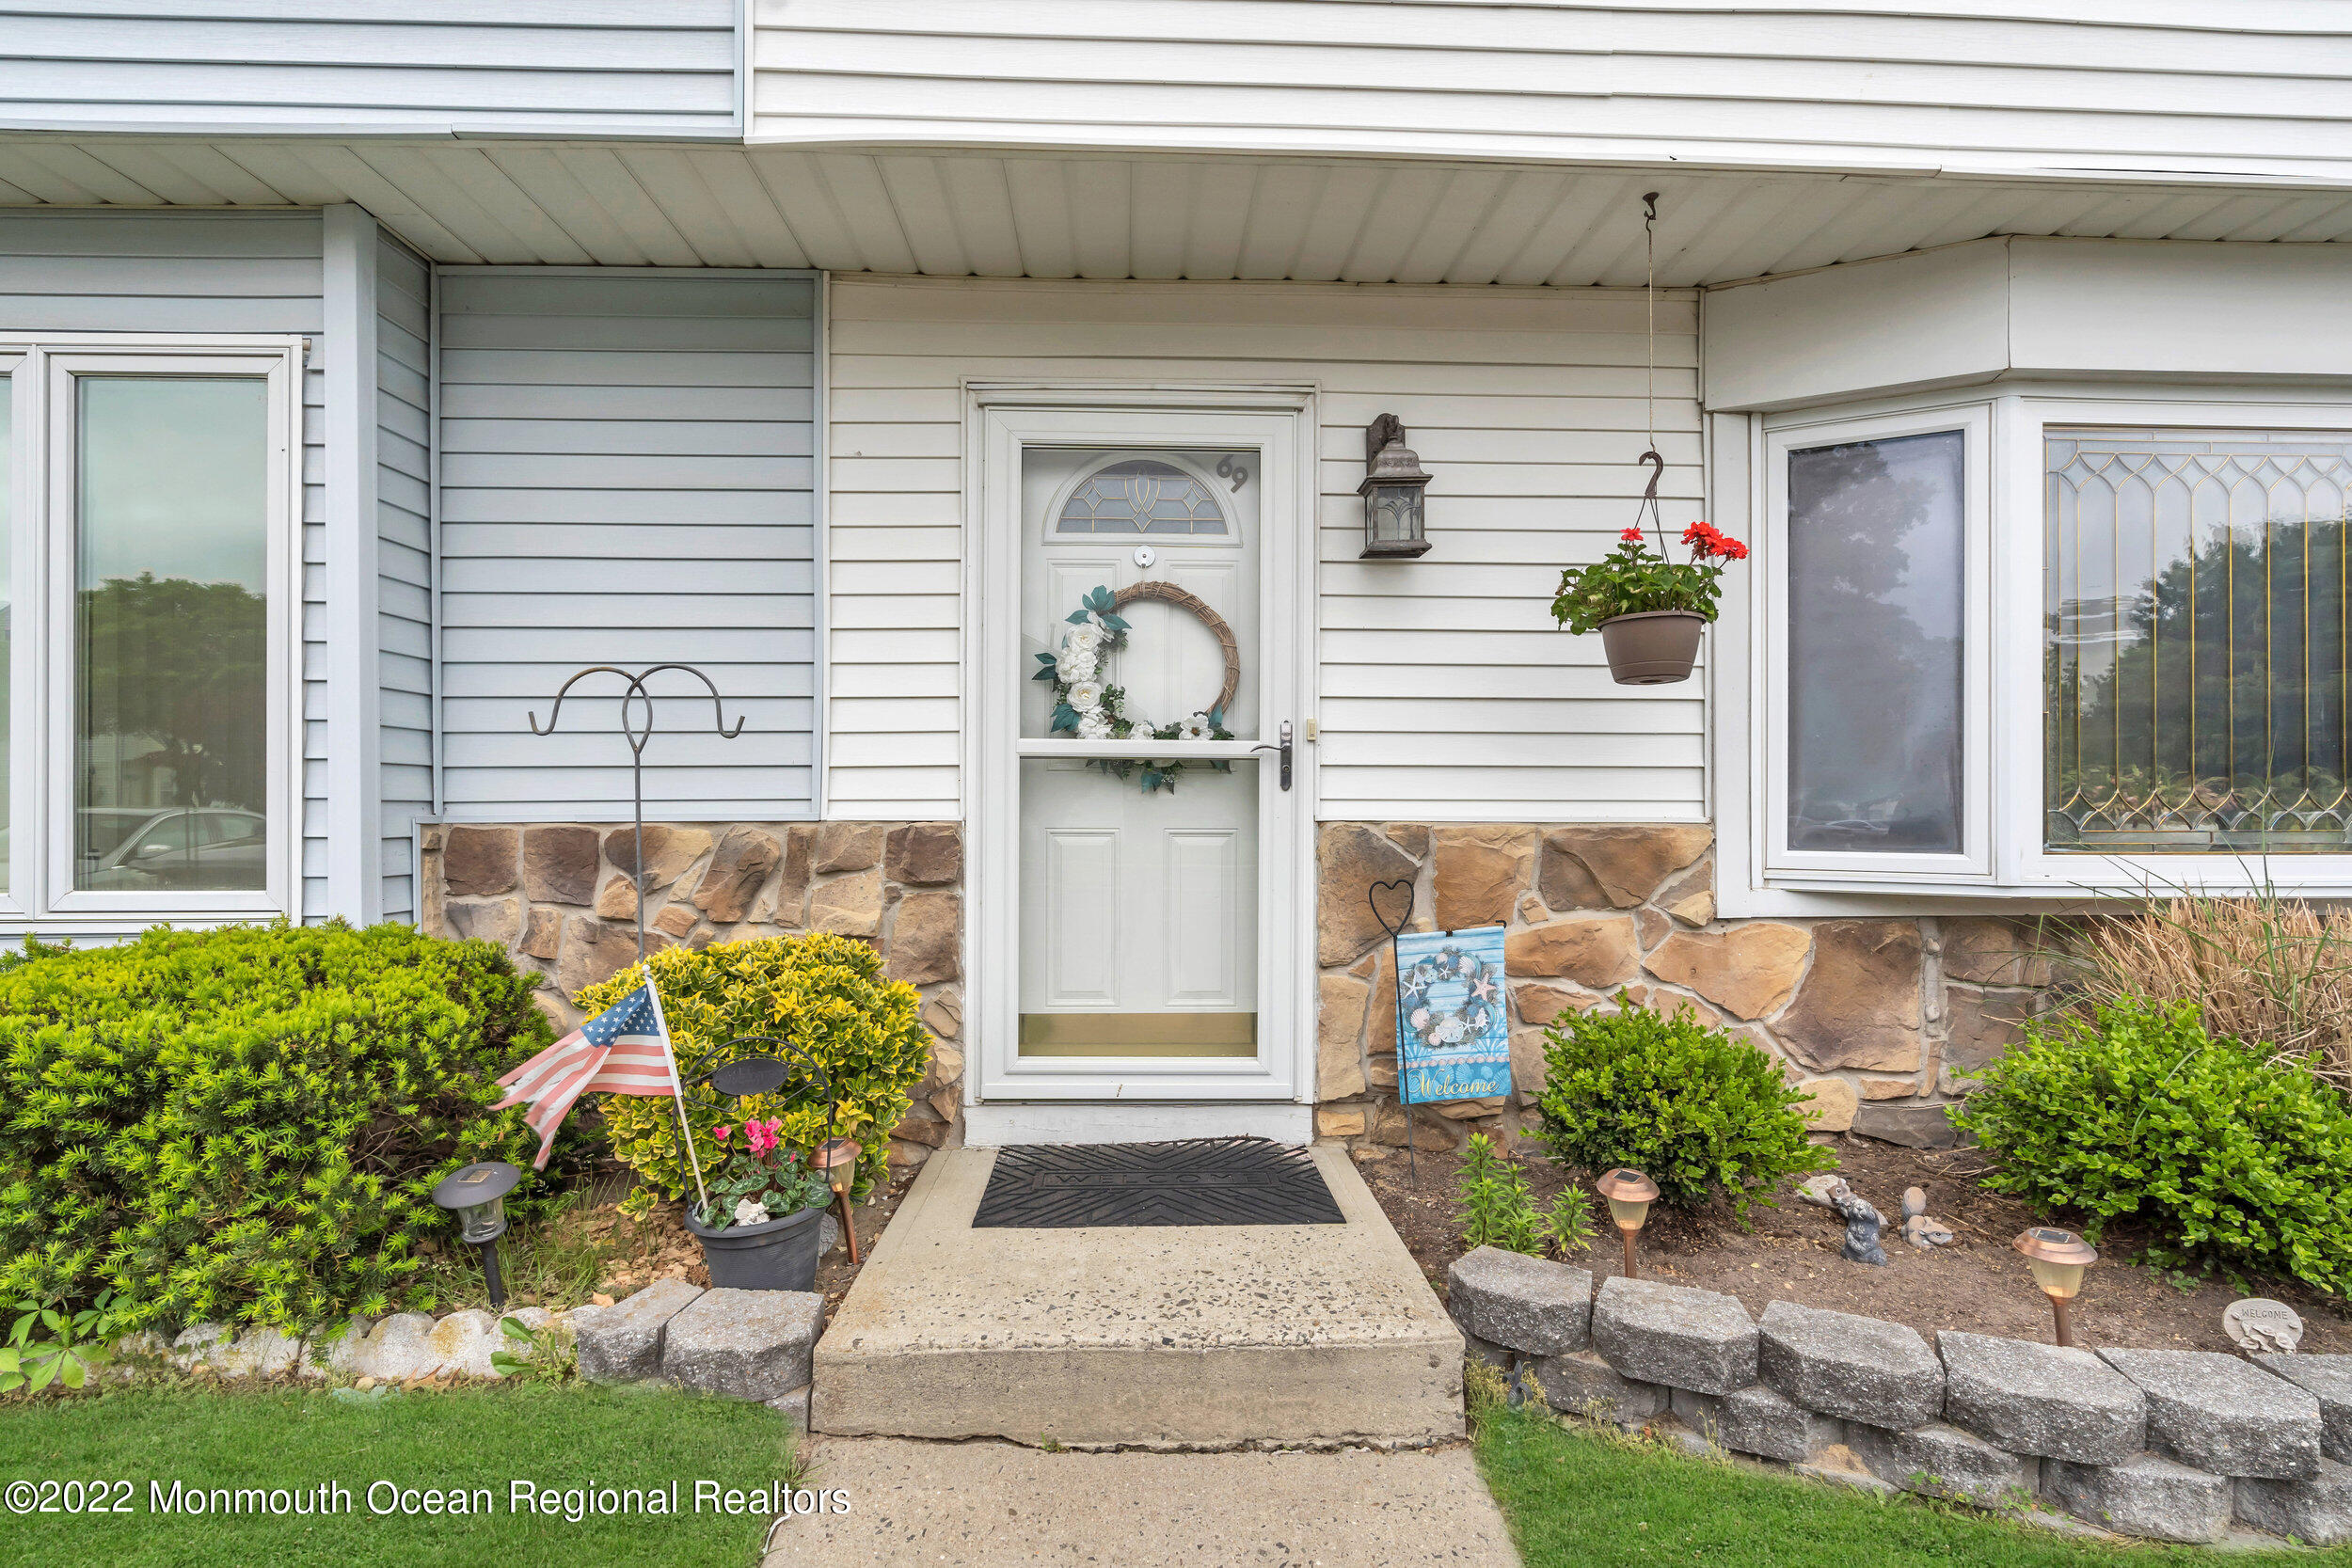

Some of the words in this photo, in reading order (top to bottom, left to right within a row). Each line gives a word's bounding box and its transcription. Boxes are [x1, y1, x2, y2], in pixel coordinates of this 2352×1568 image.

[1216, 454, 1248, 493] 69
[1407, 1069, 1500, 1097] Welcome
[1055, 1173, 1262, 1185] WELCOME
[2241, 1308, 2288, 1320] WELCOME
